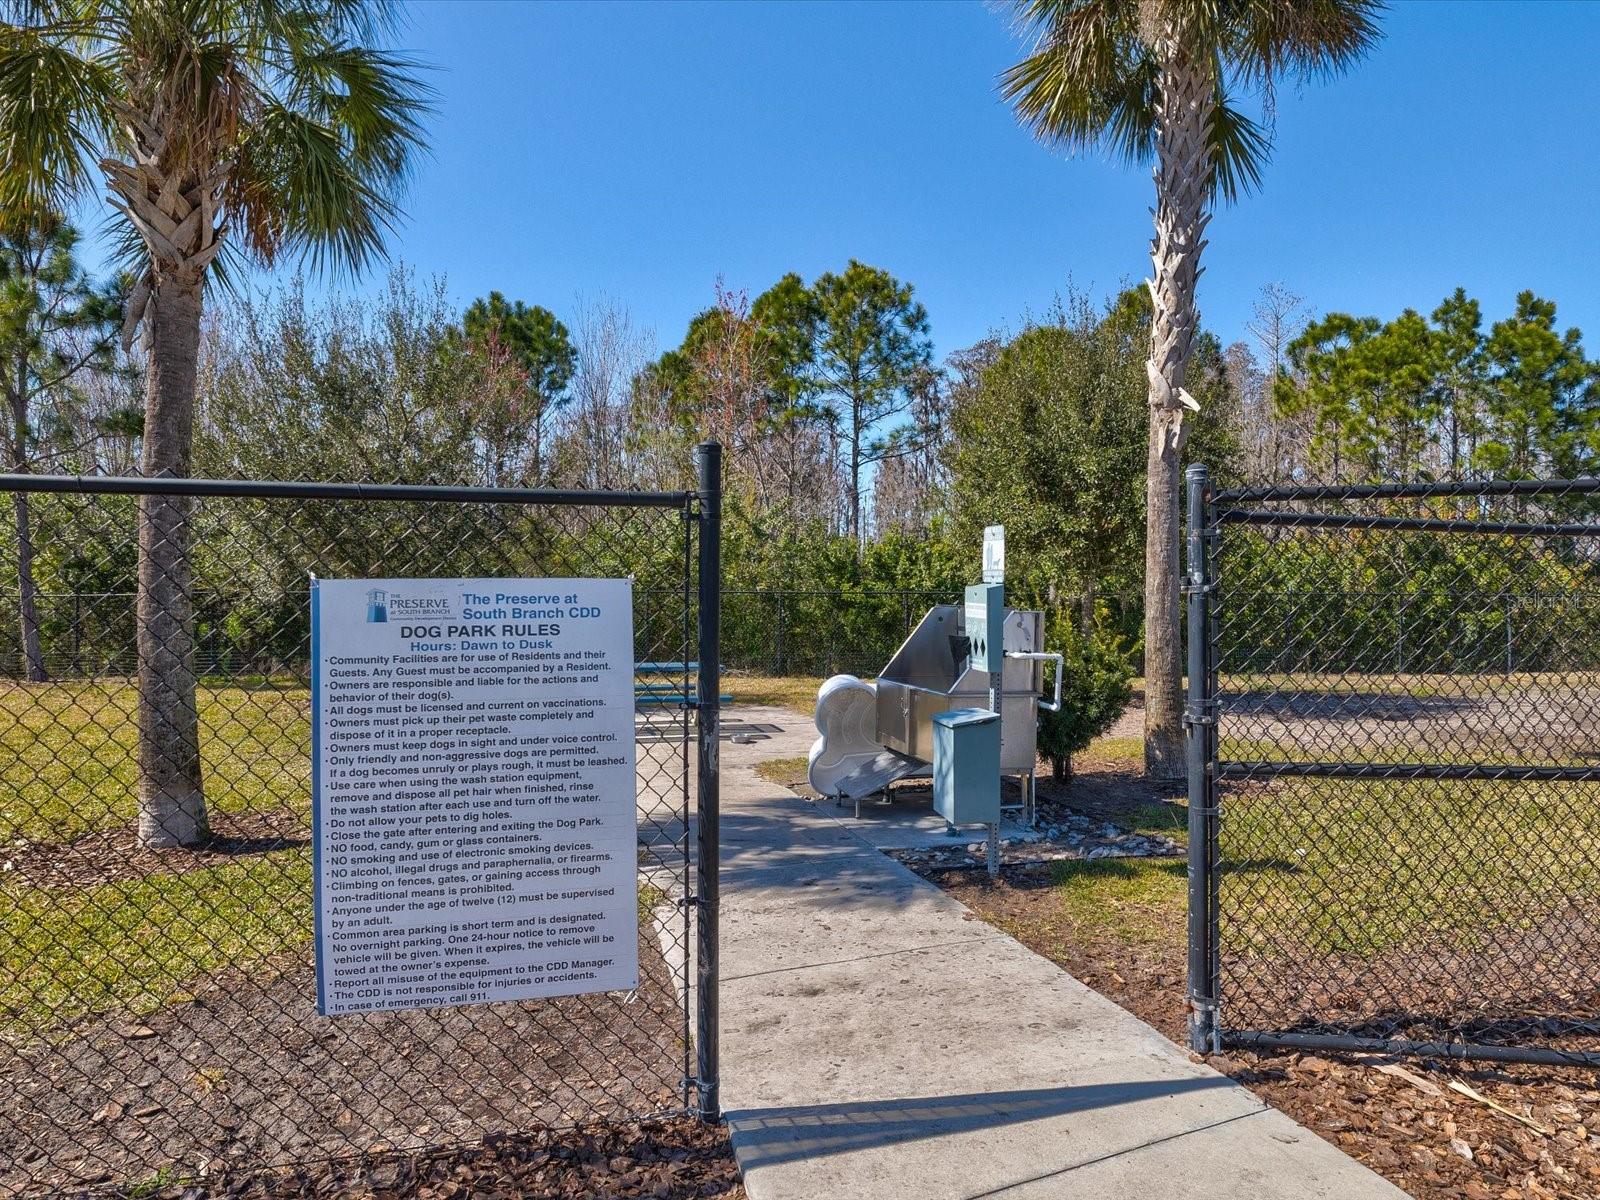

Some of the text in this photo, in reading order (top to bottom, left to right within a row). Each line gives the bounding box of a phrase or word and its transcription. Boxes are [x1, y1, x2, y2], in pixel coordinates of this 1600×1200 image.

[390, 598, 449, 608] PRESERVE
[462, 593, 578, 605] The Preserve at
[462, 606, 601, 620] South Branch CDD
[400, 623, 560, 639] DOG PARK RULES
[410, 636, 554, 652] Hours: Dawn to Dusk
[329, 649, 606, 666] Community Facilities are for use of Residents and their
[330, 661, 610, 679] Guests. Any Guest must be accompanied by a Resident.
[330, 689, 454, 703] behavior of their dog(s).
[330, 697, 606, 717] All dogs must be licensed and current on vaccinations.
[330, 709, 594, 728] Owners must pick up their pet waste completely and
[330, 724, 511, 743] dispose of it in a proper receptacle.
[330, 745, 599, 767] Only friendly and non-aggressive dogs are permitted.
[330, 770, 582, 791] Use care when using the wash station equipment,
[330, 809, 512, 828] Do not allow your pets to dig holes.
[330, 833, 543, 853] NO food, candy, gum or glass containers.
[331, 841, 594, 866] NO smoking and use of electronic smoking devices.
[331, 853, 612, 878] NO alcohol, illegal drugs and paraphernalia, or firearms.
[331, 863, 601, 891] Climbing on fences, gates, or gaining access through
[331, 882, 514, 904] non-traditional means is prohibited.
[331, 915, 392, 931] by an adult.
[332, 925, 596, 953] No overnight parking. One 24-hour notice to remove
[334, 970, 597, 999] The CDD is not responsible for injuries or accidents.
[334, 990, 490, 1012] In case of emergency, call 911.
